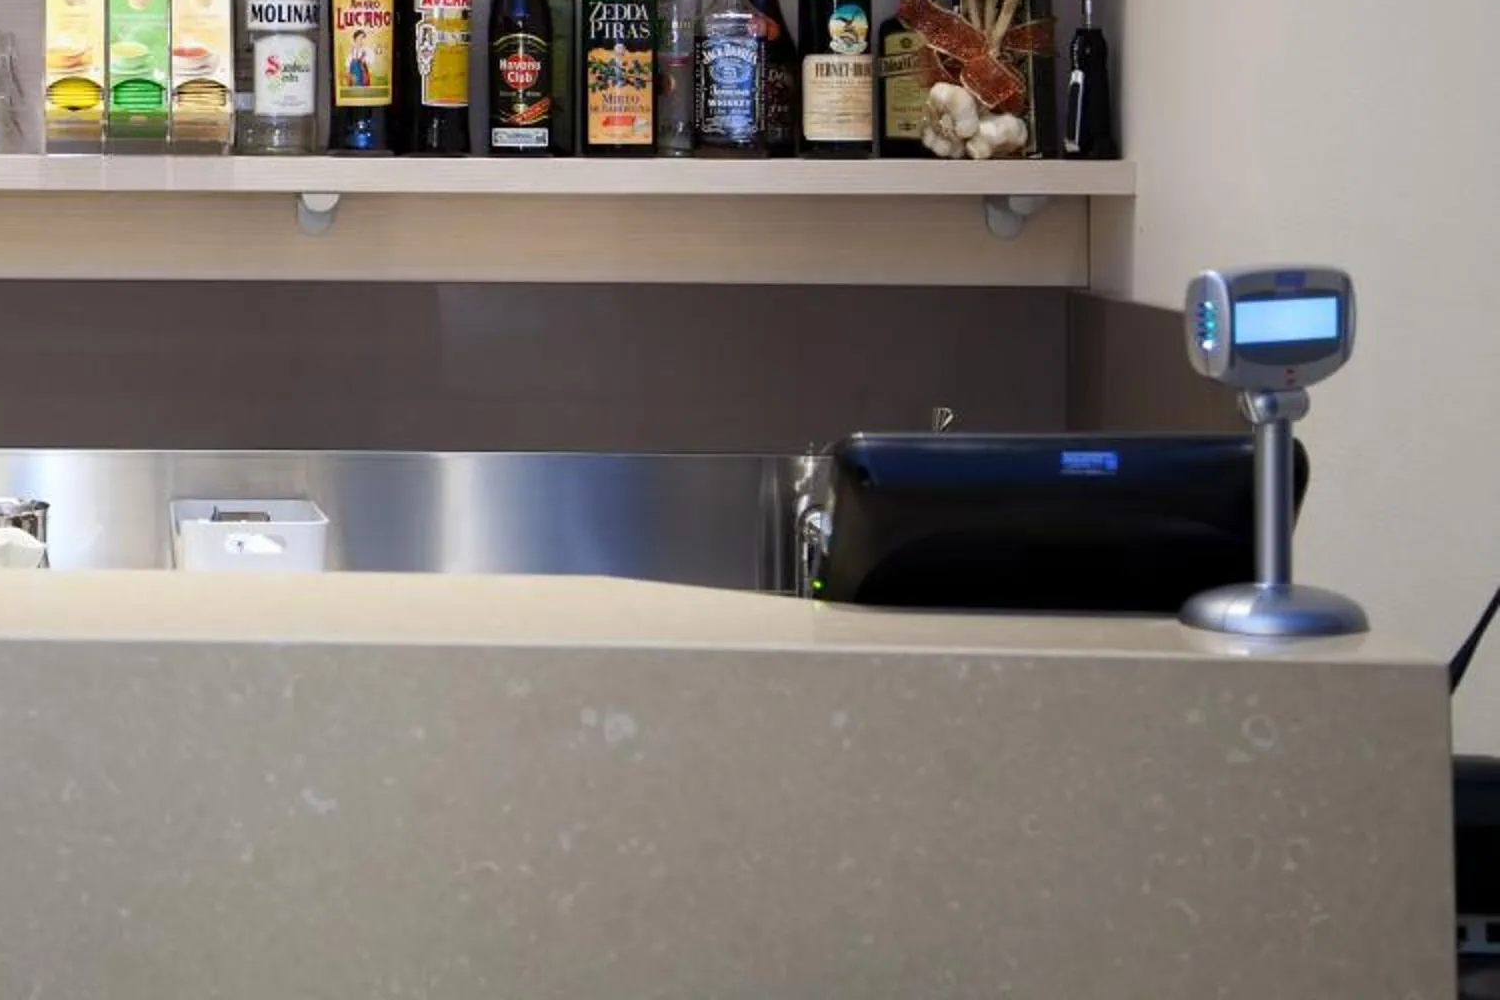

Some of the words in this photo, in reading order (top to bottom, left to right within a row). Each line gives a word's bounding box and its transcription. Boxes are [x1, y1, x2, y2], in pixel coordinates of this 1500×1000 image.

[337, 8, 392, 31] LUCANO
[589, 1, 649, 21] ZEDDA
[589, 21, 651, 40] PIRAS
[507, 71, 534, 84] Club
